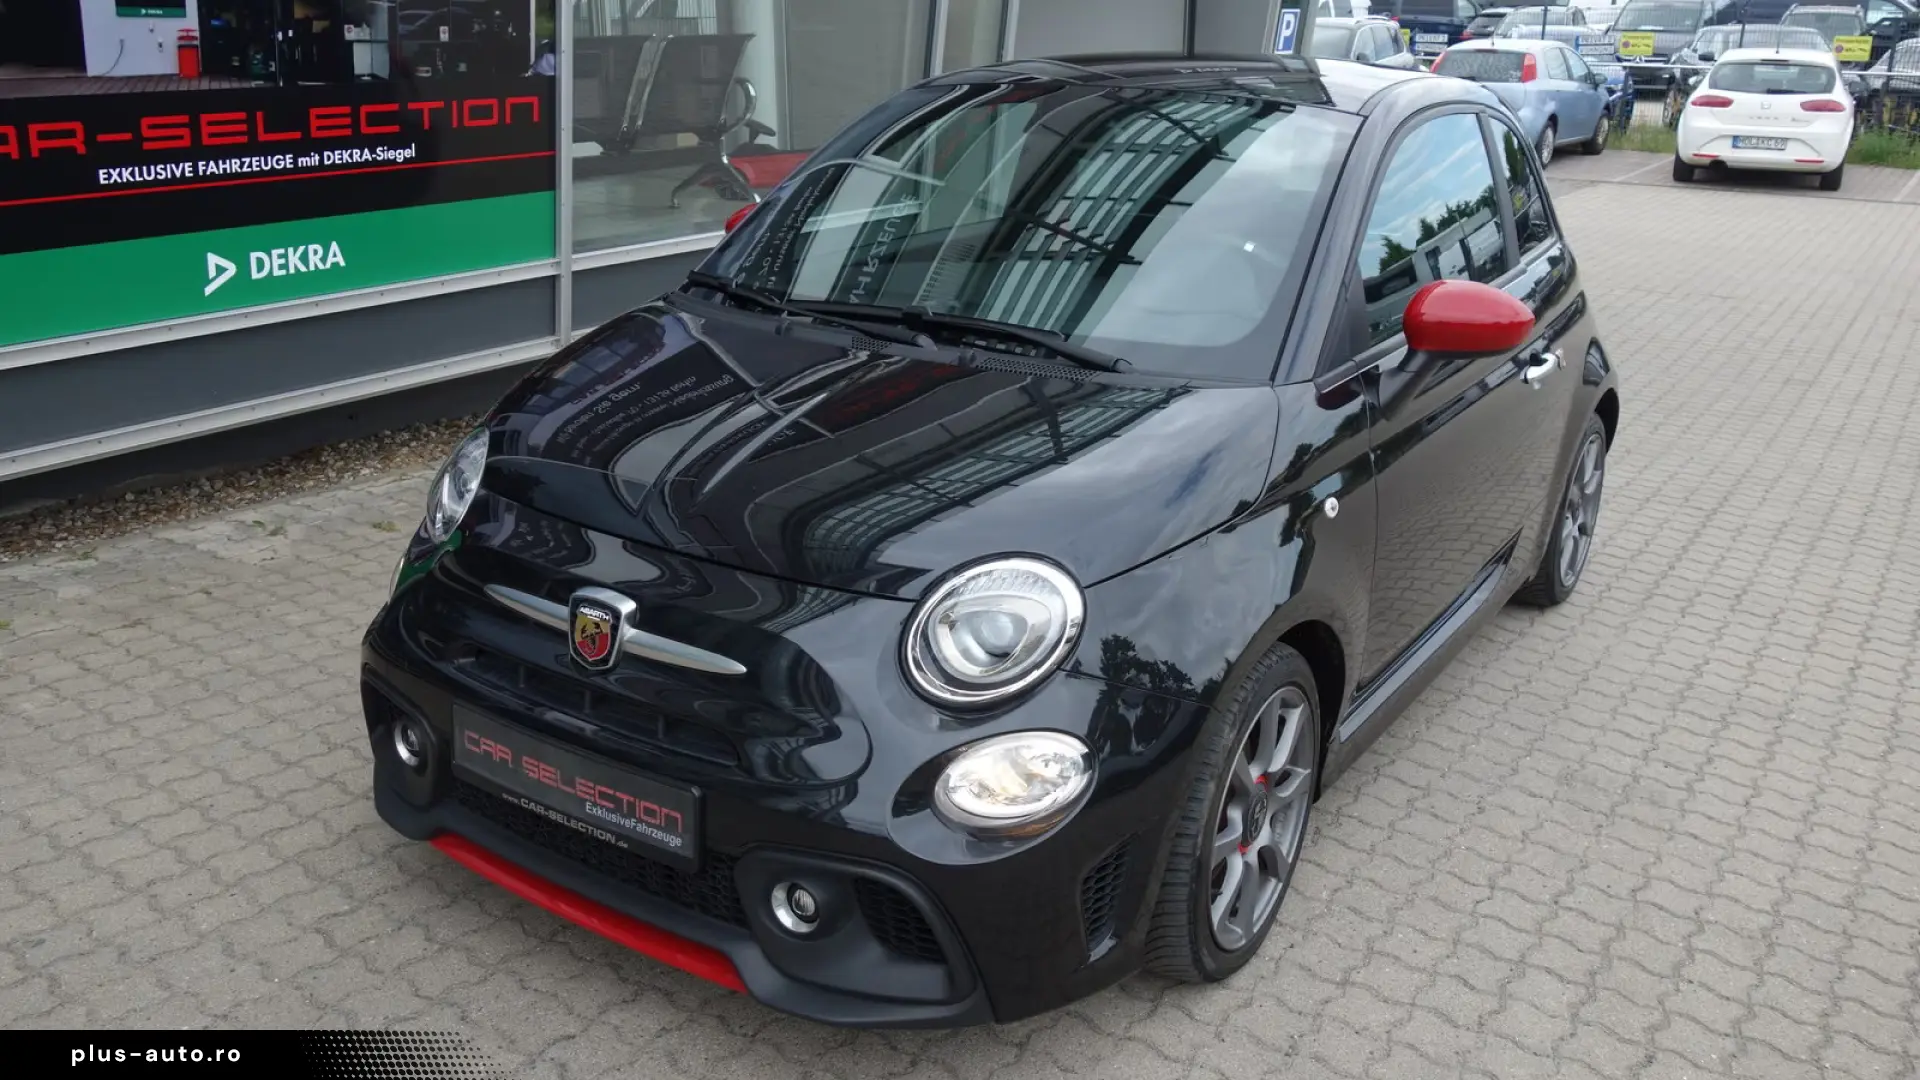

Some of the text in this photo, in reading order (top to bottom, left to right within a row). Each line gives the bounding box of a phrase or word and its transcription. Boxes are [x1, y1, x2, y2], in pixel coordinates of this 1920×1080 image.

[1278, 13, 1295, 50] P
[98, 143, 416, 185] EXKLUSIVE FAHRZEUGE mit DEKRA-Siegel
[249, 240, 346, 280] DEKRA
[579, 606, 610, 621] ABARTH
[464, 729, 683, 833] CAR SELECTION
[585, 801, 683, 847] ExklusiveFahrzeuge
